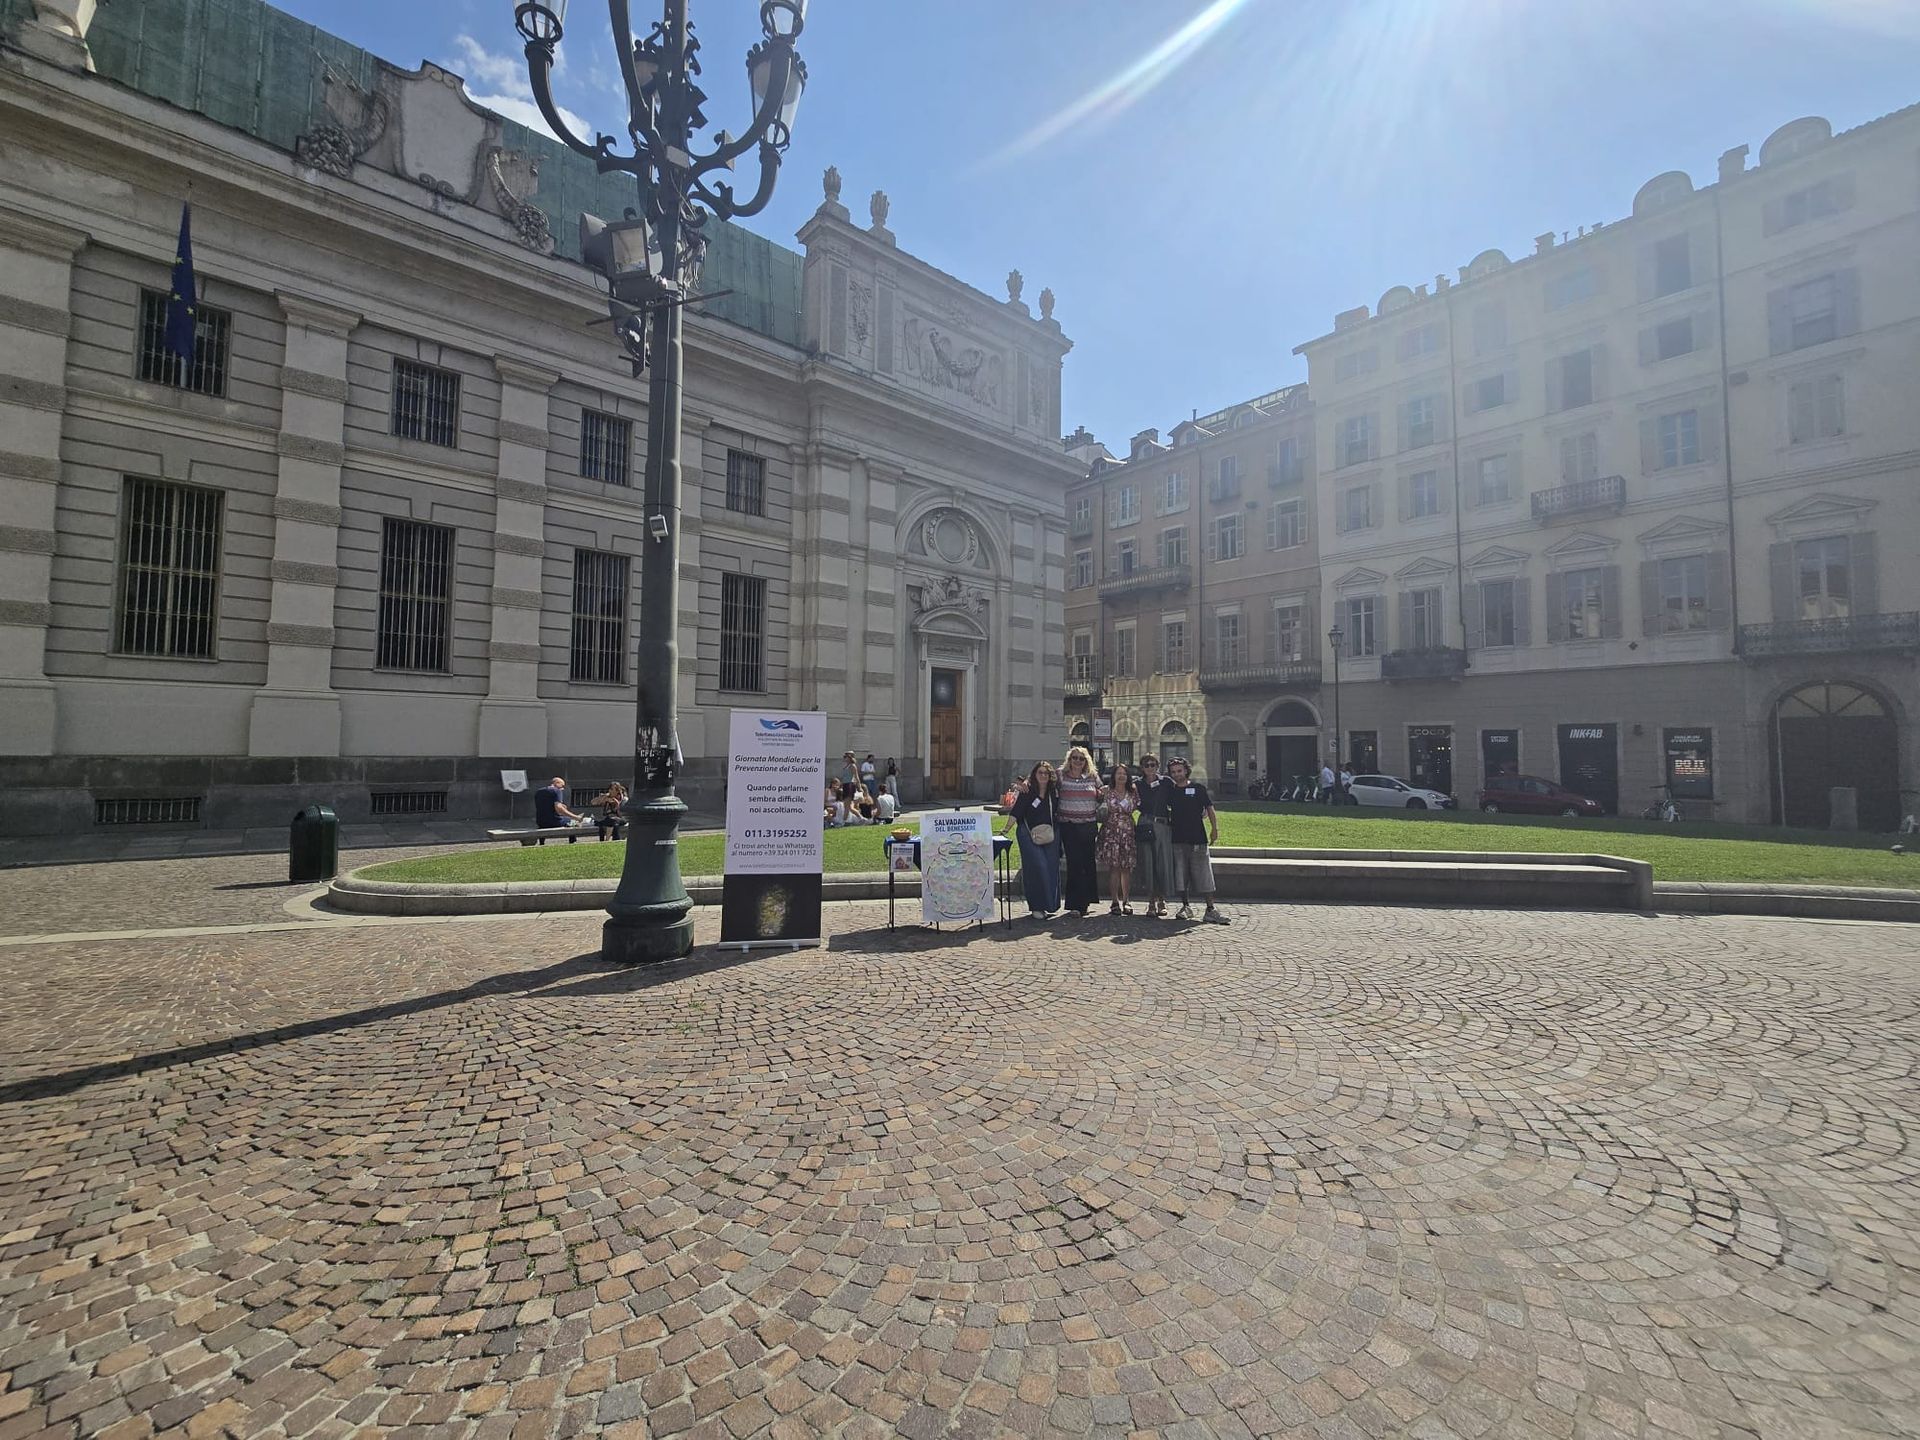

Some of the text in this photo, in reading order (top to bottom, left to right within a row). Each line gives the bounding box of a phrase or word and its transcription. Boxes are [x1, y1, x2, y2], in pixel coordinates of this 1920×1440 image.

[734, 754, 767, 763] Giornata
[768, 755, 801, 763] Mondiale
[790, 765, 819, 773] Suicidio
[746, 784, 809, 793] Quando parlarne
[748, 795, 806, 803] sembra difficile,
[749, 806, 805, 814] noi ascoltiamo.
[934, 818, 977, 826] SALVADANAIO
[744, 829, 808, 838] 011.3195252
